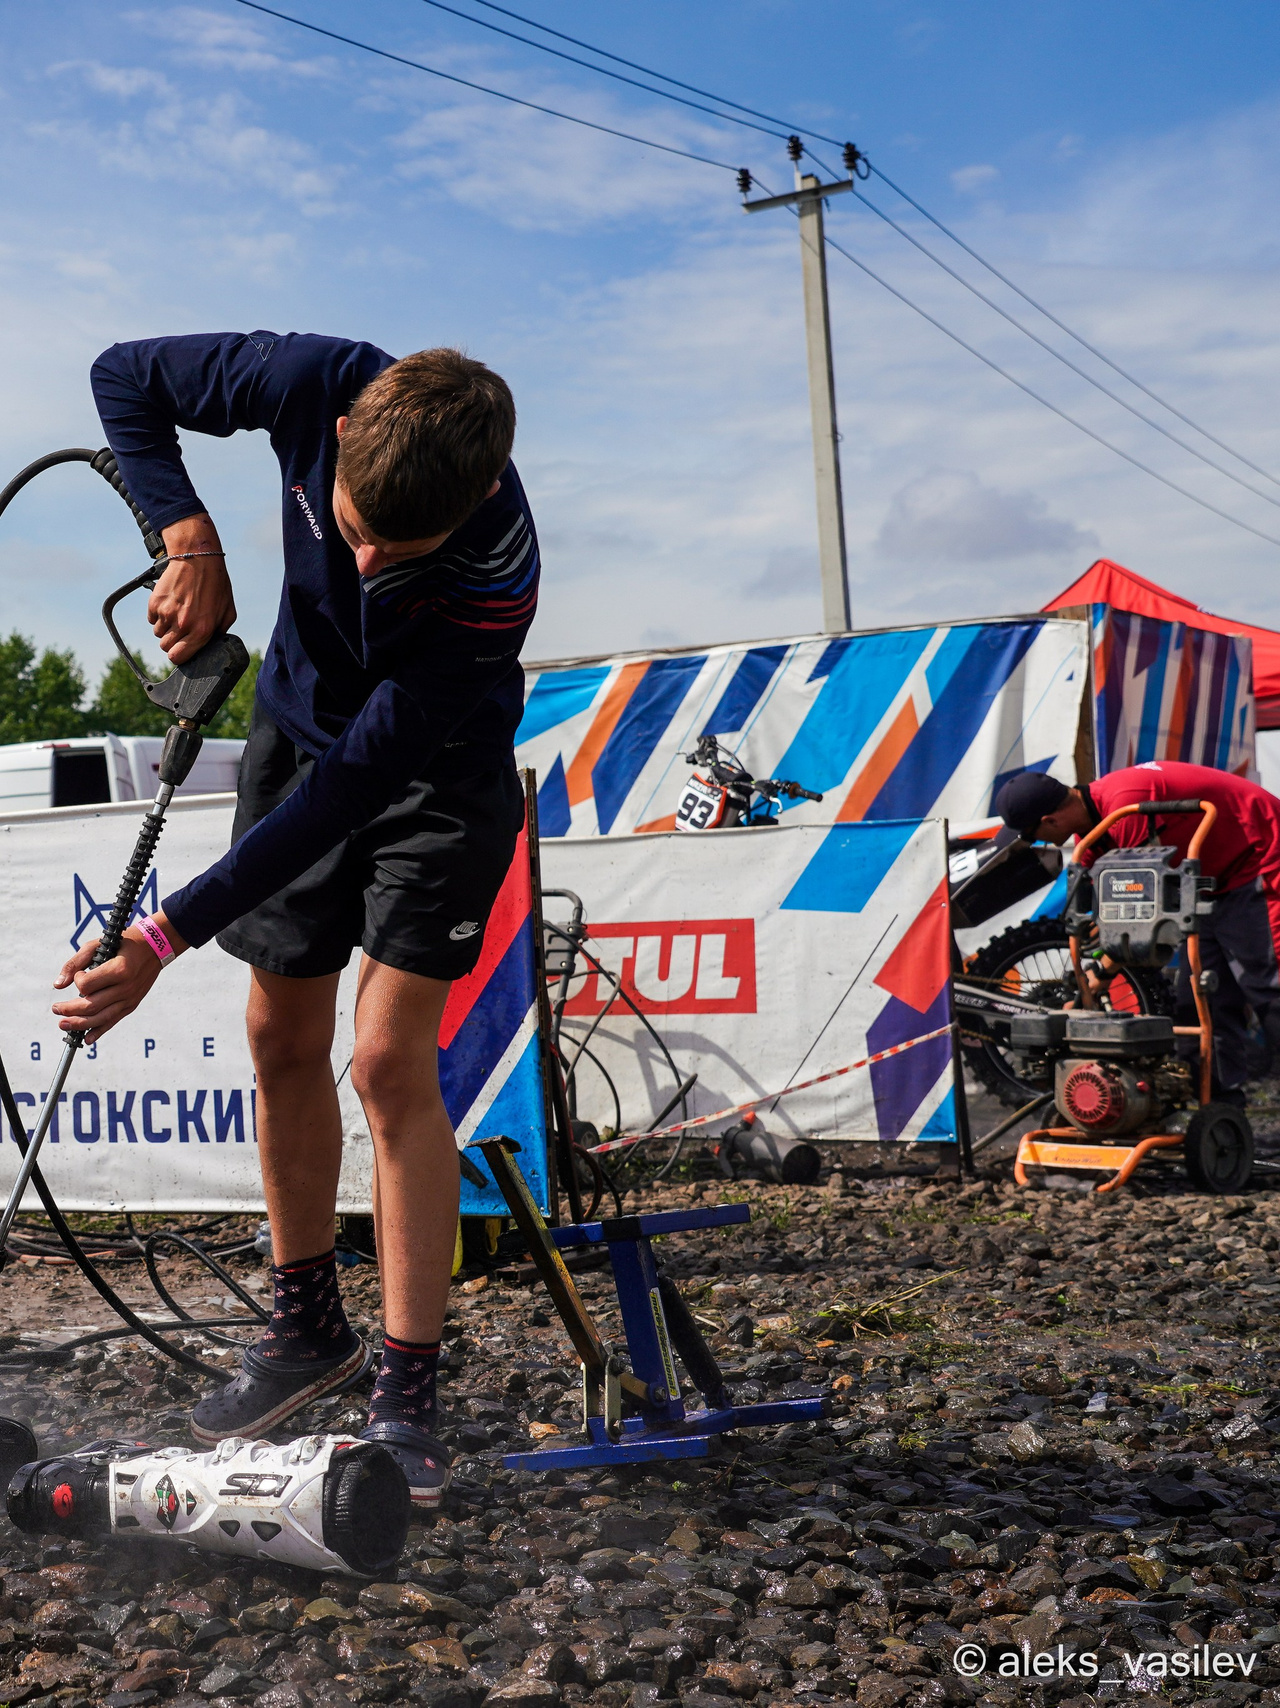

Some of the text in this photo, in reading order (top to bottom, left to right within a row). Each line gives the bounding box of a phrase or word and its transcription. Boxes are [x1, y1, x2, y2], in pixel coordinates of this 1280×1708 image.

[291, 485, 323, 540] FORWARD
[677, 792, 715, 829] 93
[547, 933, 741, 1002] TUL
